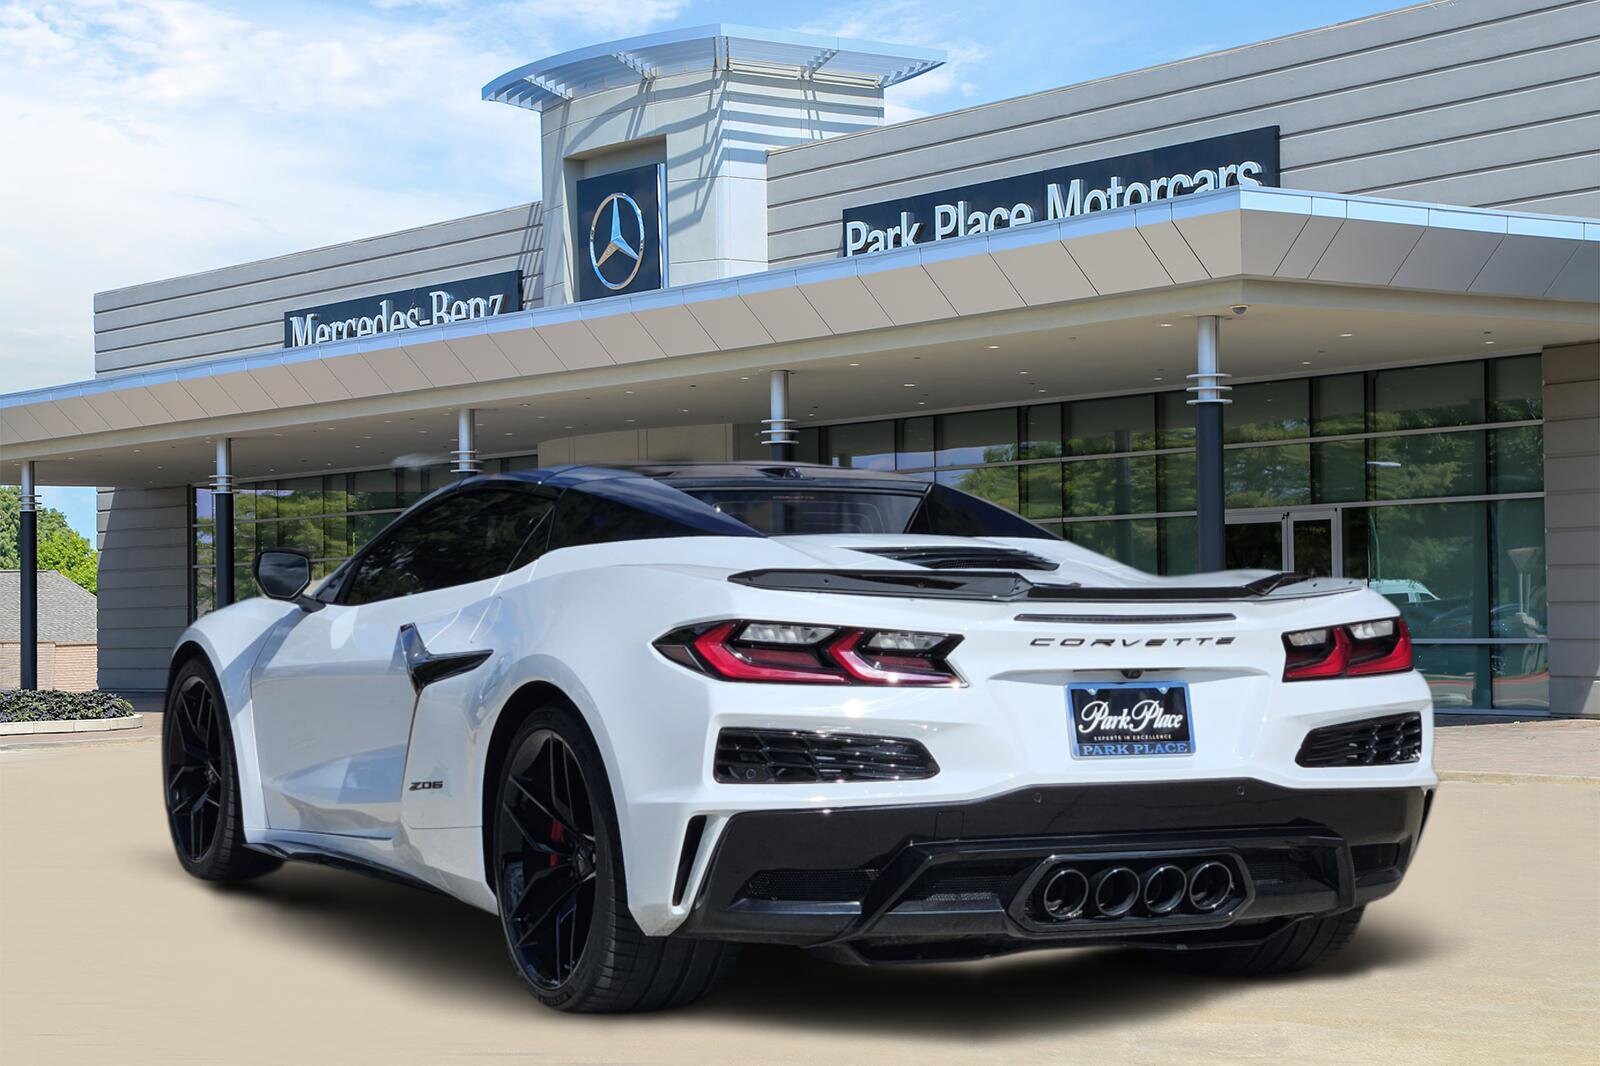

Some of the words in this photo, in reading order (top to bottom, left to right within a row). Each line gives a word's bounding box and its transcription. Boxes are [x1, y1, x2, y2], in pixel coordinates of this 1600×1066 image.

[846, 211, 922, 257] Park
[935, 200, 1034, 242] Place
[1030, 636, 1237, 648] CORVETTE
[1078, 700, 1132, 733] Park
[1129, 700, 1184, 732] Place
[1083, 744, 1129, 756] PARK
[1133, 743, 1188, 755] PLACE
[408, 780, 444, 791] Z06
